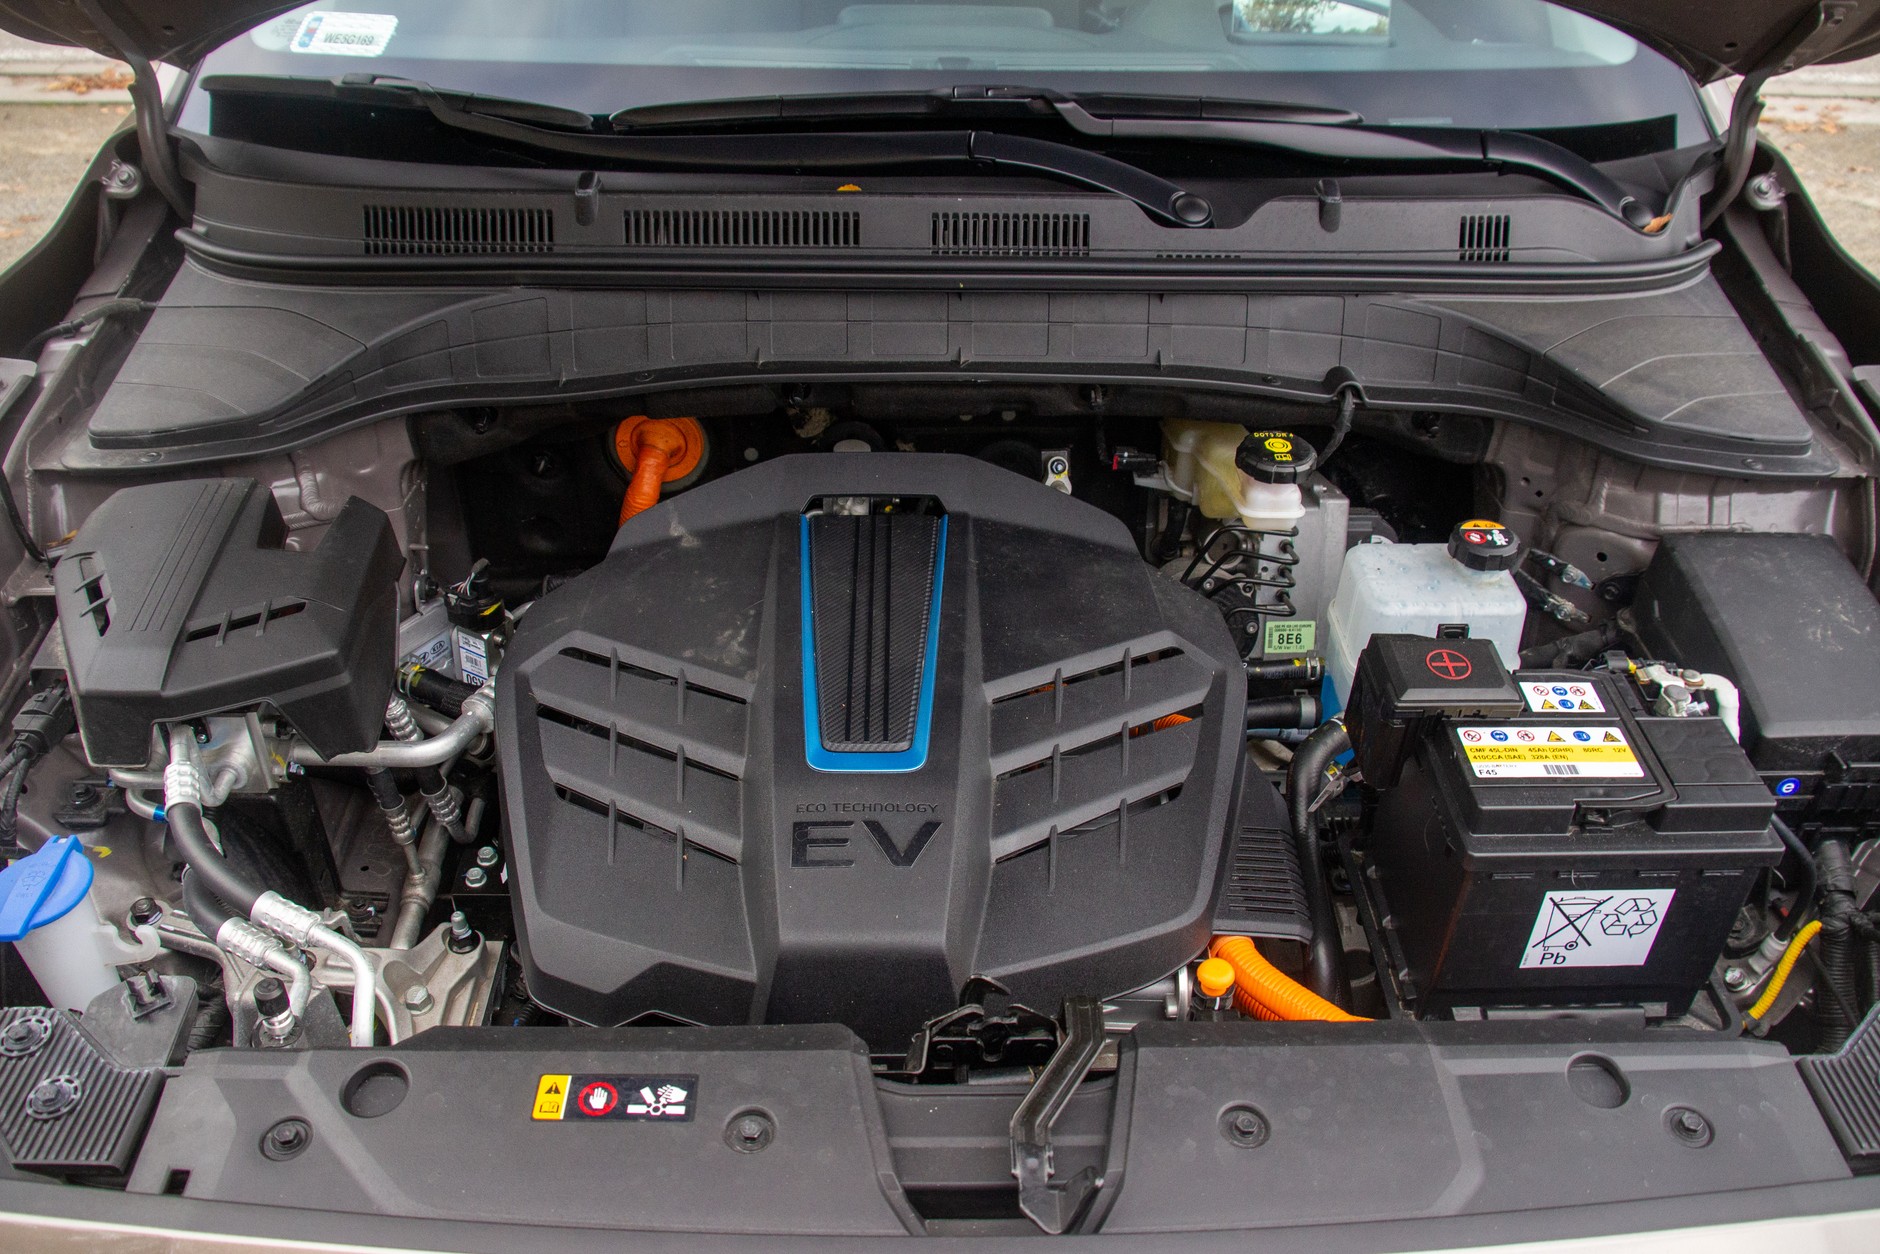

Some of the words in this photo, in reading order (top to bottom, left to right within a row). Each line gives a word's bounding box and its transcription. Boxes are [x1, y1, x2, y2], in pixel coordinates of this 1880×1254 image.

[1278, 633, 1302, 645] 8E6
[431, 641, 444, 653] KIA
[1782, 782, 1795, 794] e
[795, 802, 827, 814] ECO
[832, 802, 939, 814] TECHNOLOGY
[791, 820, 944, 869] EV
[1539, 952, 1567, 965] Pb
